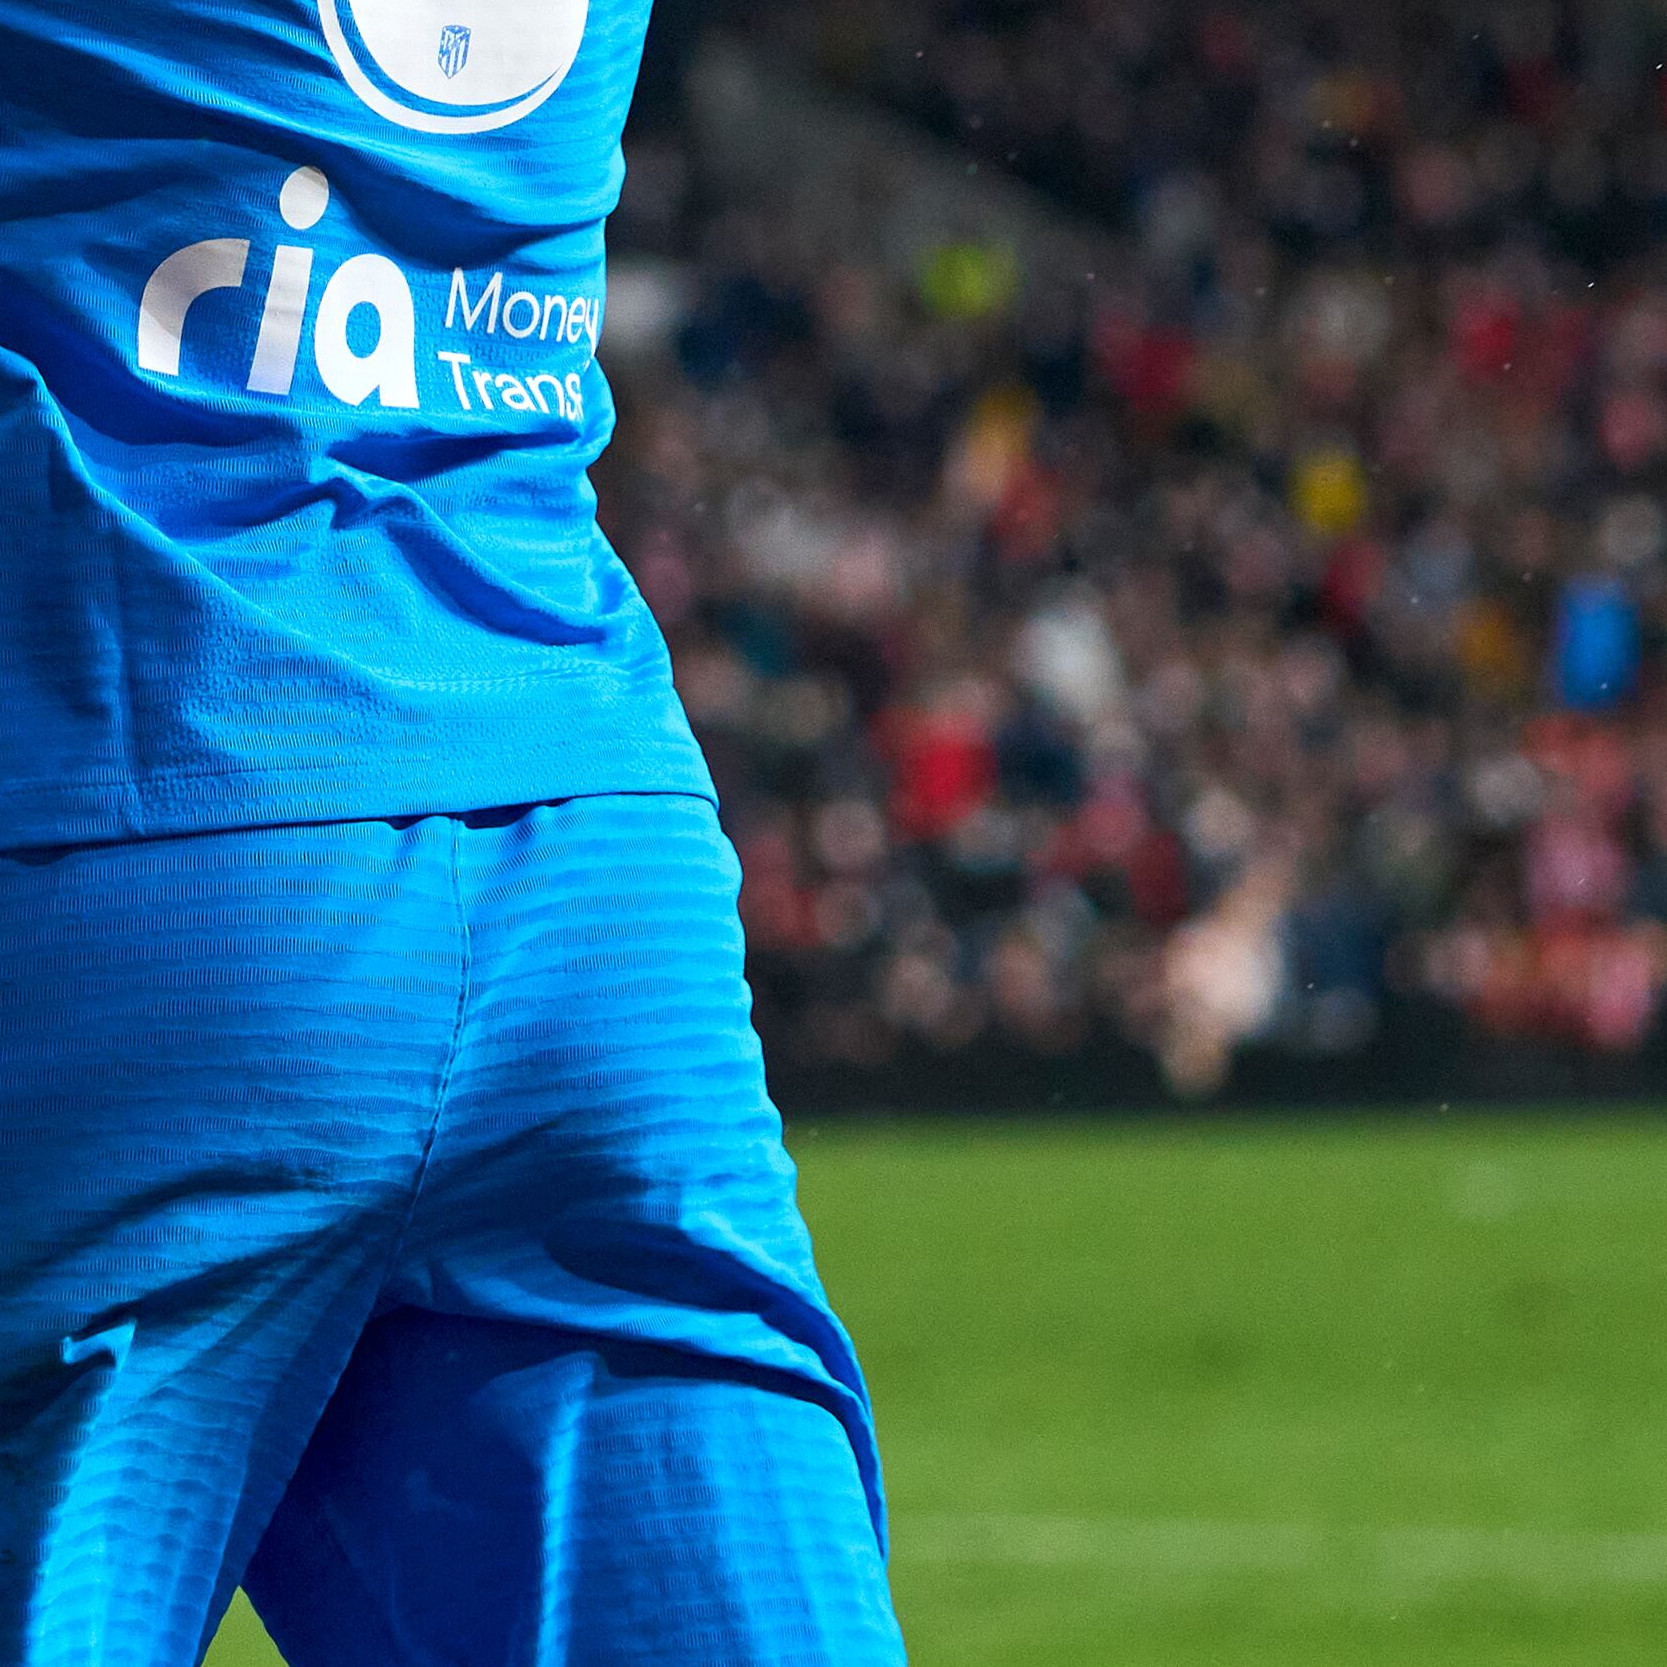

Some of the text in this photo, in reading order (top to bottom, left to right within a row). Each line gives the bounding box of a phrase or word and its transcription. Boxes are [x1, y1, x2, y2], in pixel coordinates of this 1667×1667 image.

[138, 165, 420, 409] ria
[444, 267, 599, 371] Money
[438, 350, 584, 421] Trans
